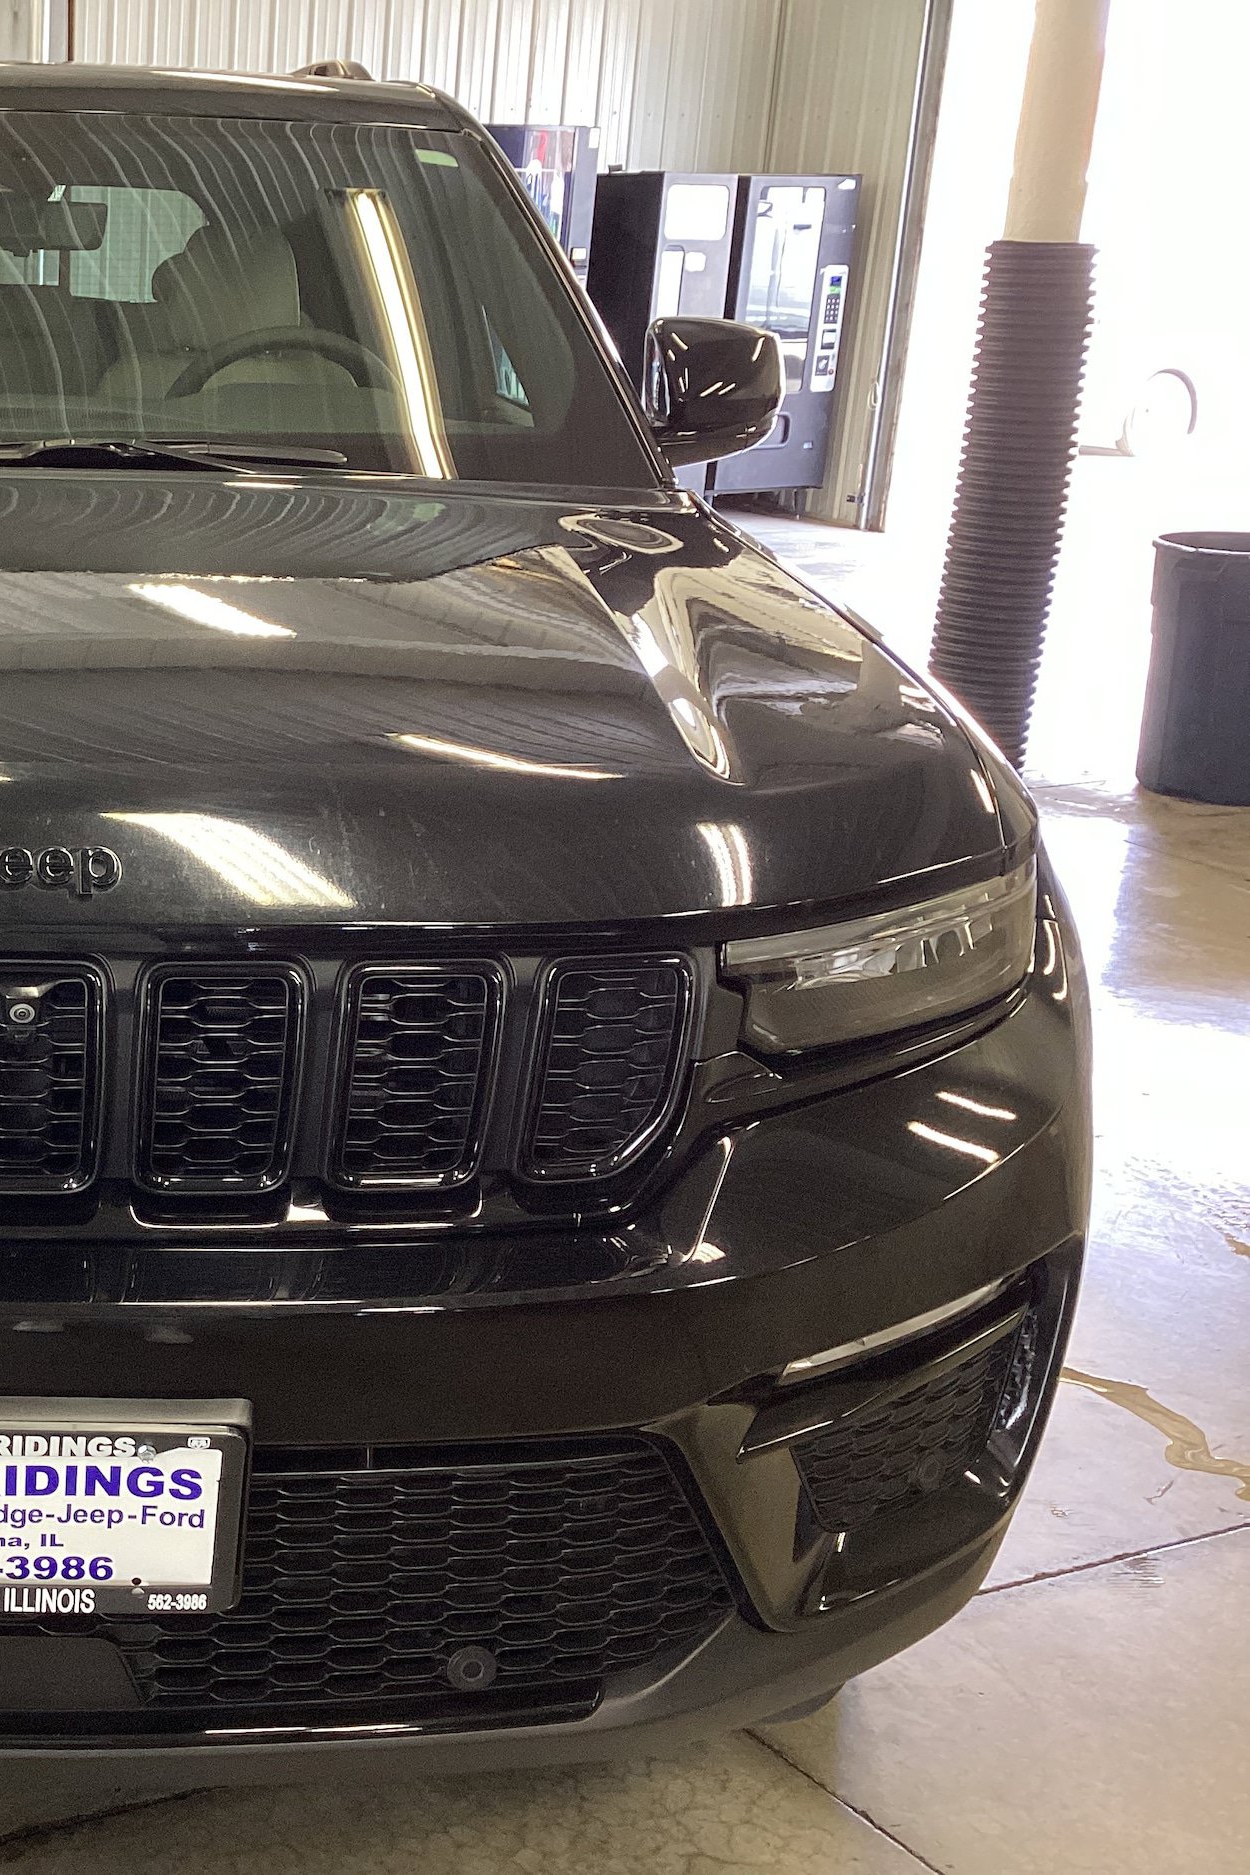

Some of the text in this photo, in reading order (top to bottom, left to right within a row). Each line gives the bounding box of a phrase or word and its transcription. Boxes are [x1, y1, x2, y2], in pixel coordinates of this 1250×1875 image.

[40, 1533, 64, 1547] IL
[4, 1587, 96, 1614] ILLINOIS
[147, 1593, 208, 1611] 562-3986
